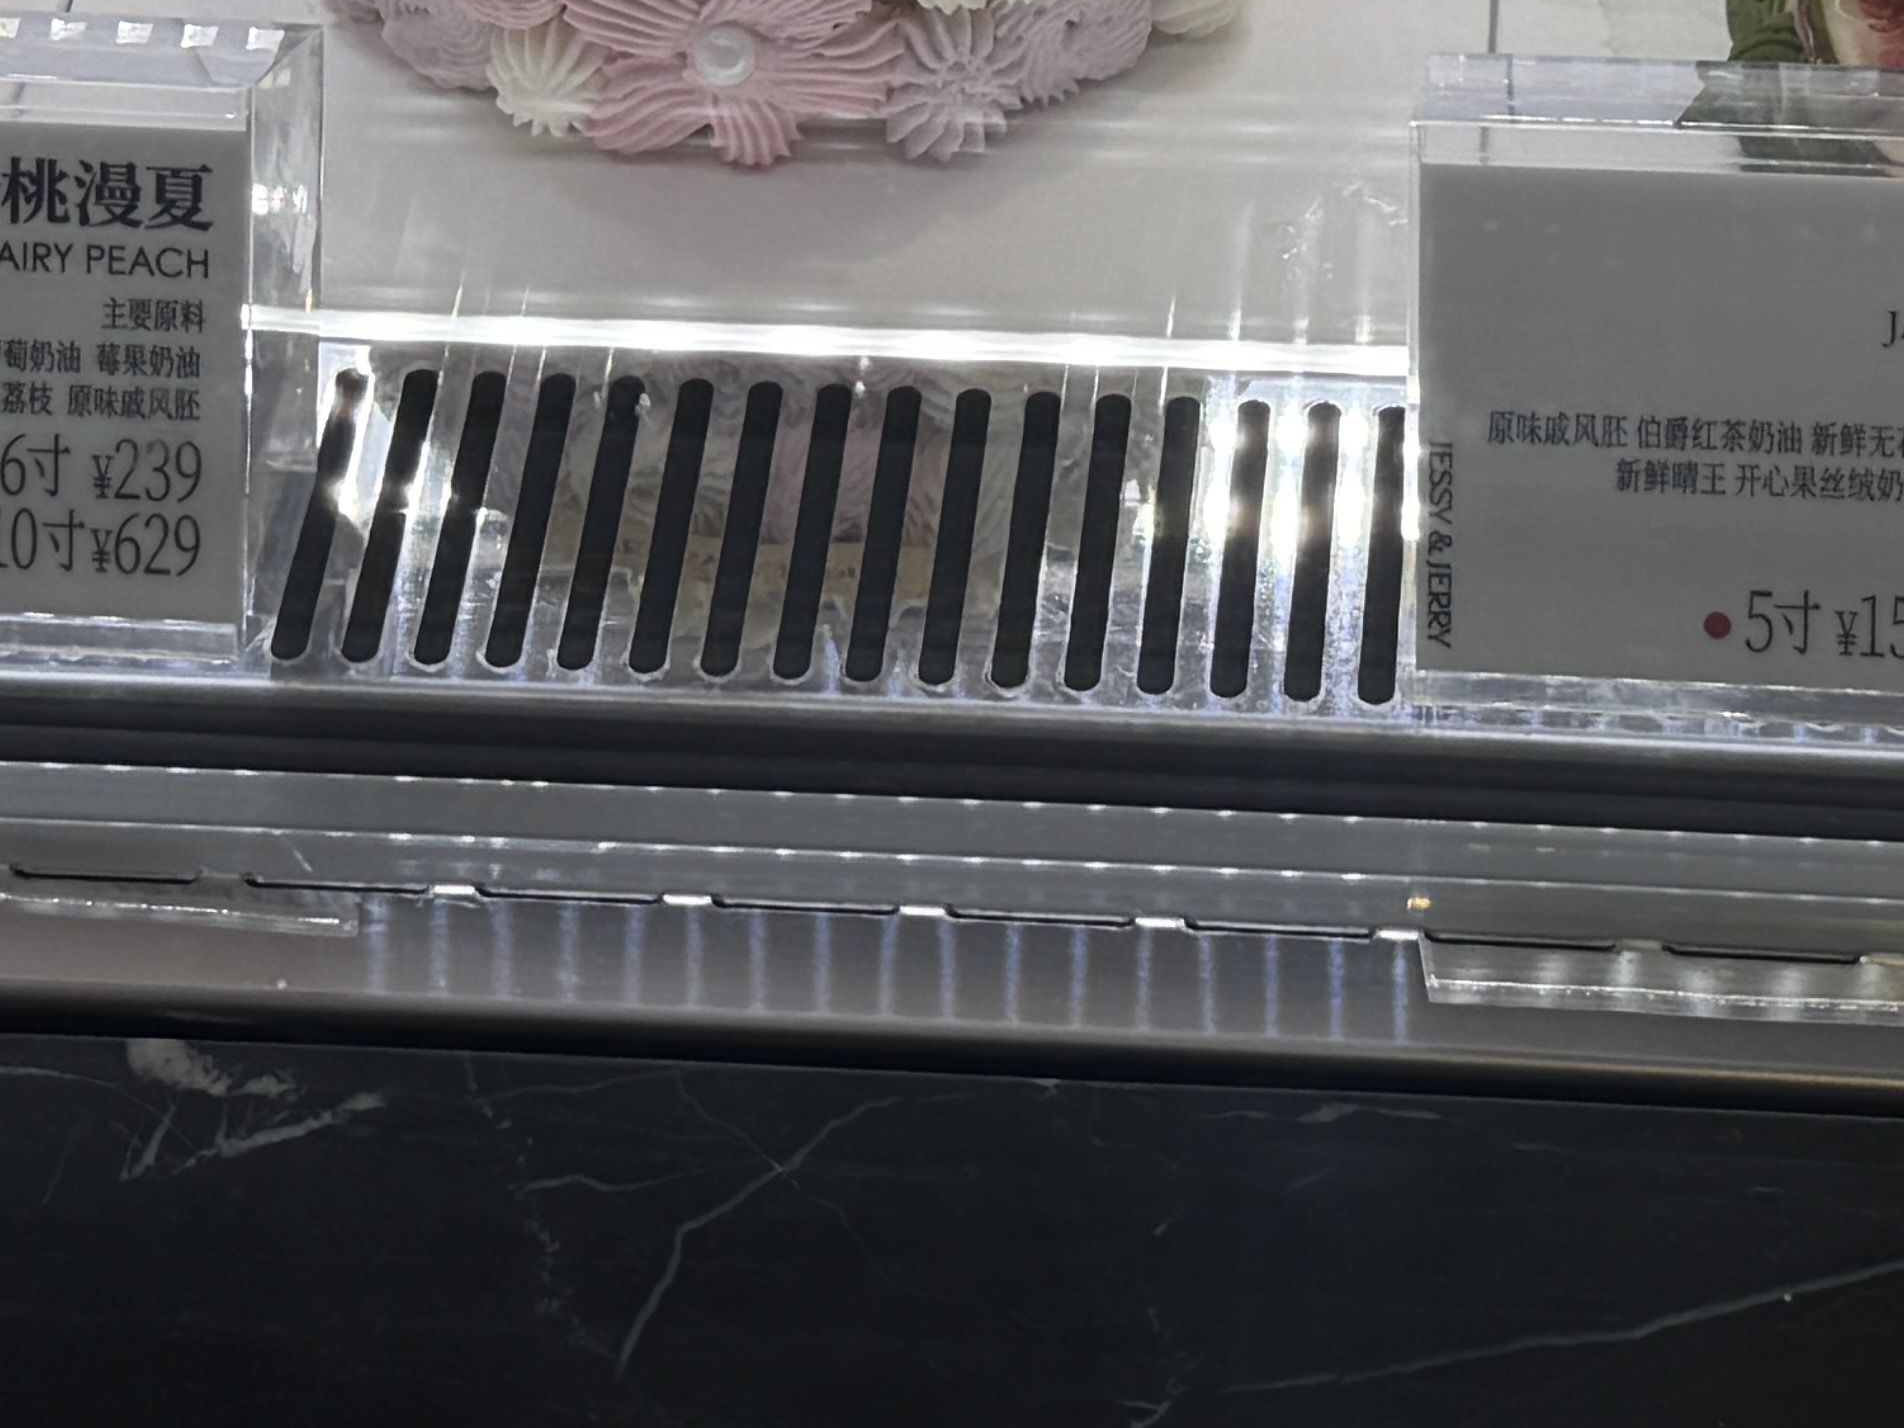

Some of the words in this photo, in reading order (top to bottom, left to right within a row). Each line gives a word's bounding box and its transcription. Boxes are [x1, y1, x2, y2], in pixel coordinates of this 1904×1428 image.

[85, 244, 211, 279] PEACH
[101, 297, 207, 334] 主要原料
[97, 341, 202, 379] 莓果奶油
[67, 383, 202, 421] 原味戚风胚
[1488, 410, 1629, 448] 原味戚风胚
[1637, 414, 1803, 455] 伯爵红茶奶油
[1428, 441, 1454, 525] JESSY
[1615, 457, 1727, 495] 新鲜晴王
[1427, 529, 1453, 556] &
[1426, 559, 1452, 649] JERRY
